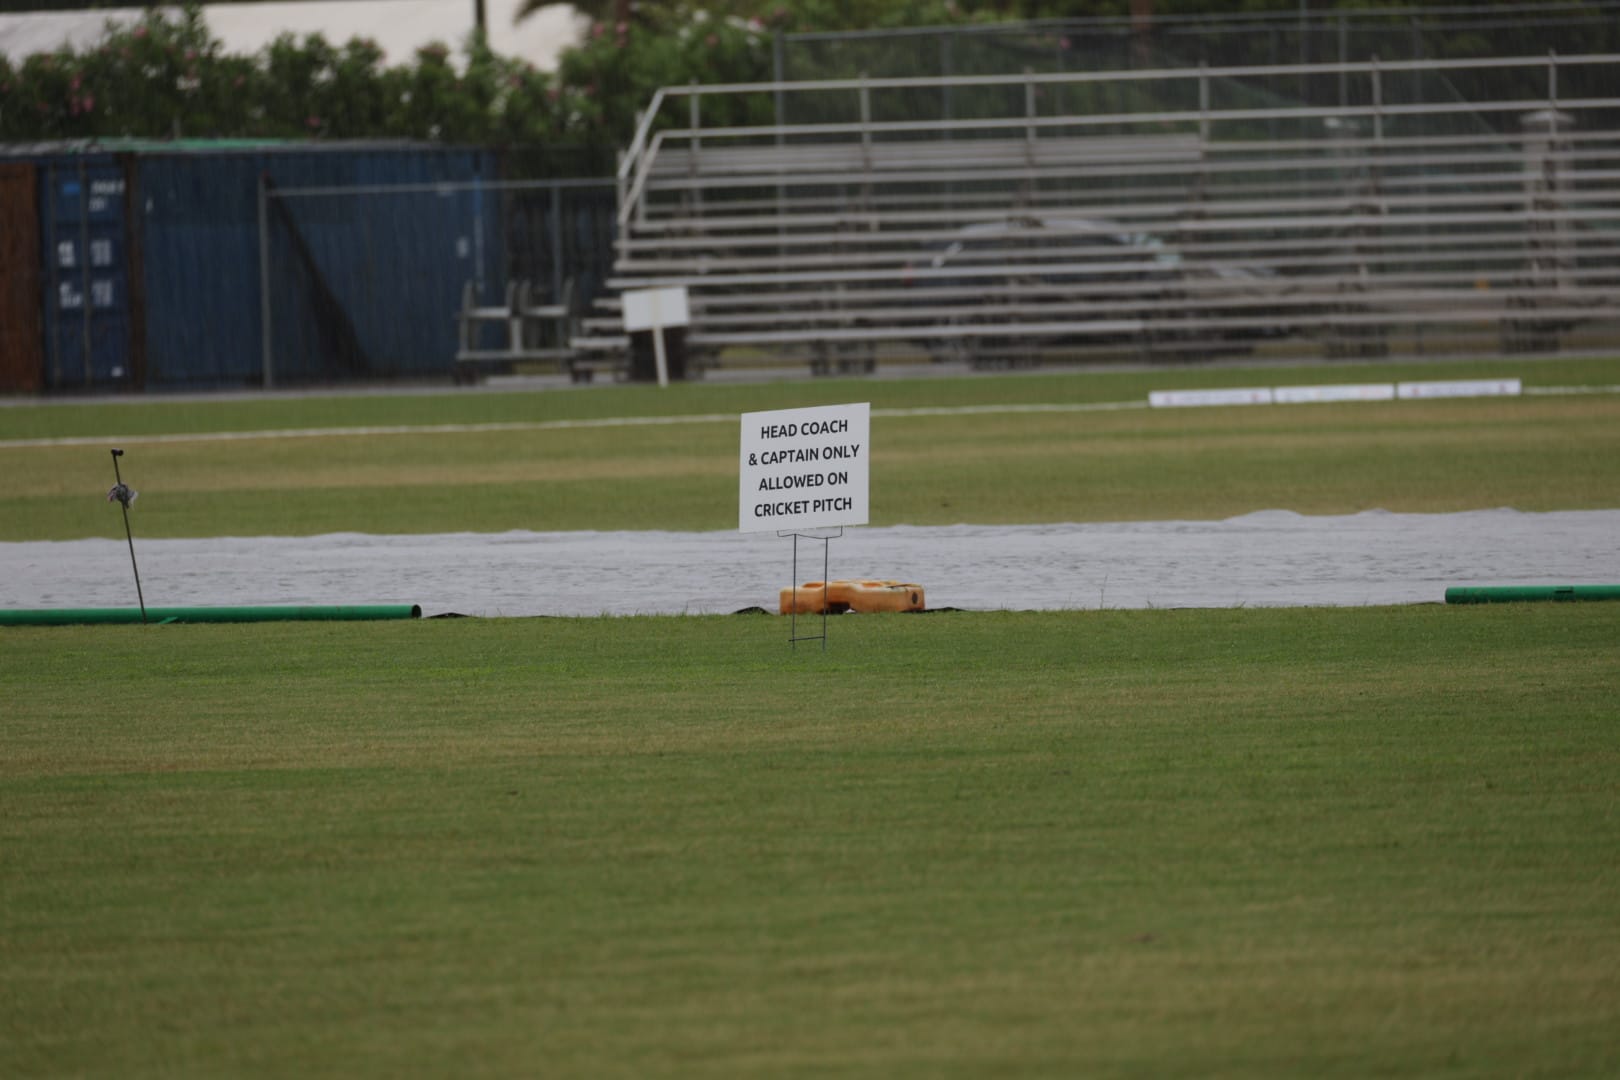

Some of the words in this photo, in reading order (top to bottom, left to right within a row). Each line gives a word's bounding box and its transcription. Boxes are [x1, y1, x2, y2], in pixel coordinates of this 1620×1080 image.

[761, 425, 797, 439] HEAD
[801, 420, 848, 435] COACH
[749, 453, 758, 465] &
[761, 448, 819, 464] CAPTAIN
[823, 444, 860, 459] ONLY
[759, 474, 824, 490] ALLOWED
[828, 472, 848, 485] ON
[755, 501, 809, 517] CRICKET
[813, 497, 852, 512] PITCH
